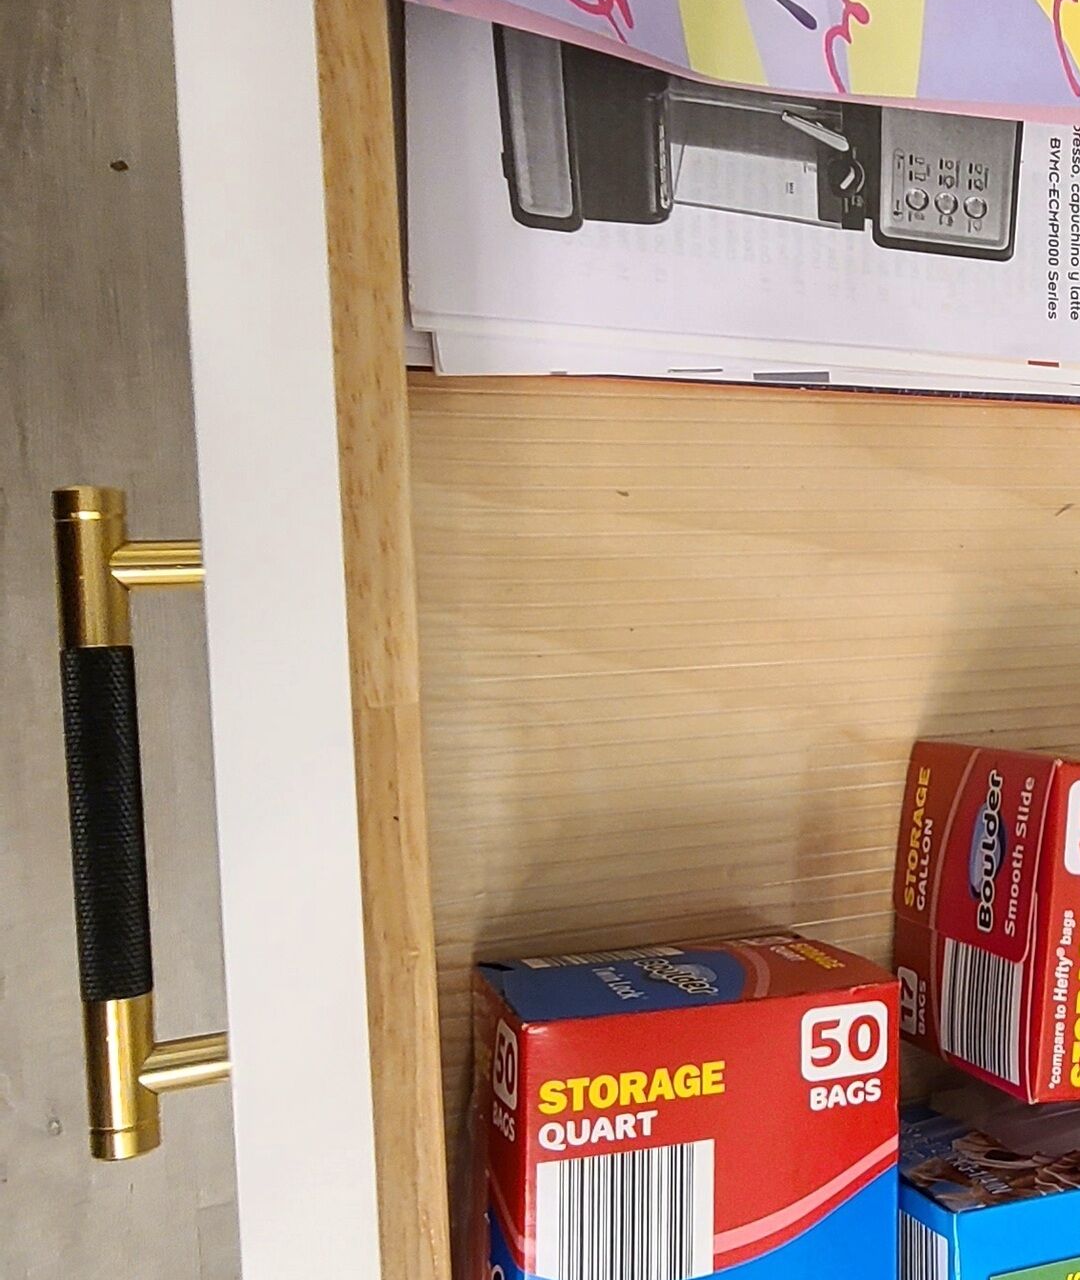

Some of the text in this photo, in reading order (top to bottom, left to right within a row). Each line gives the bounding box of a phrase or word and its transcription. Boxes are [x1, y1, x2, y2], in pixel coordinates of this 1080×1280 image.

[1048, 137, 1060, 320] BVMC-ECMP1000 Series
[1068, 271, 1080, 281] y
[903, 766, 931, 909] STORAGE
[915, 817, 933, 912] GALLON
[977, 767, 1004, 934] Boulder
[1004, 775, 1036, 938] Smooth Slide
[1058, 909, 1075, 946] bags
[1053, 1003, 1068, 1020] to
[808, 1013, 882, 1069] 50
[536, 1059, 727, 1117] STORAGE
[808, 1077, 883, 1112] BAGS
[536, 1108, 660, 1152] QUART
